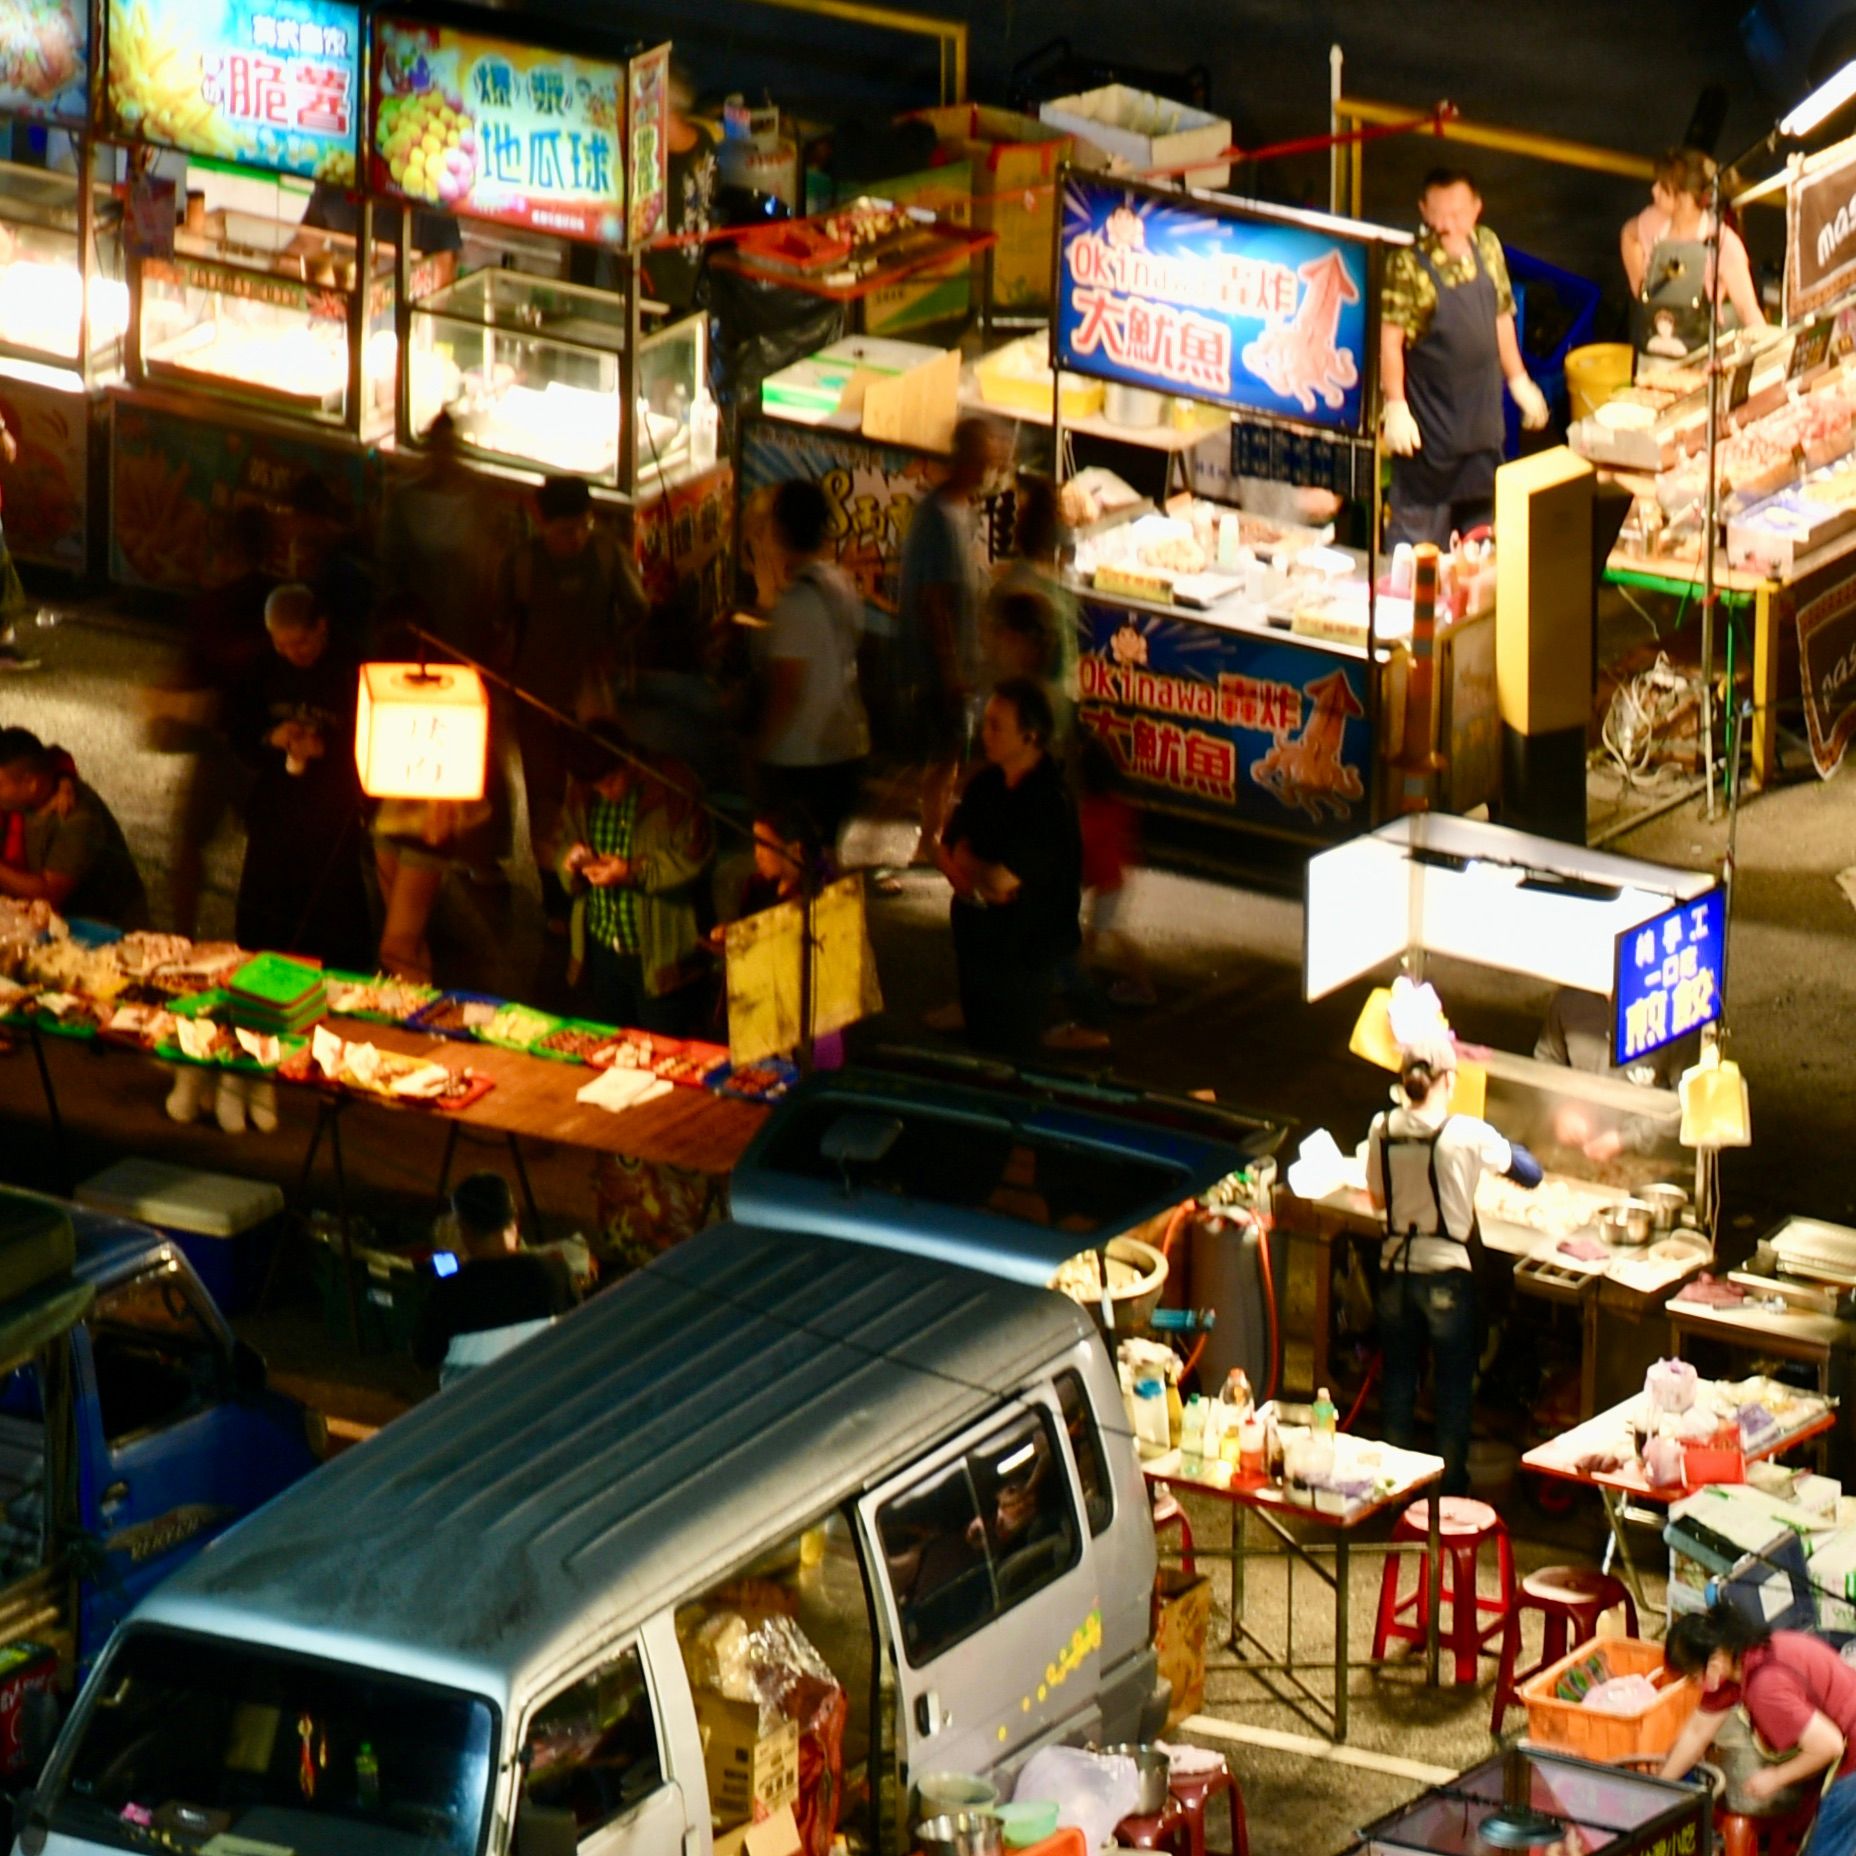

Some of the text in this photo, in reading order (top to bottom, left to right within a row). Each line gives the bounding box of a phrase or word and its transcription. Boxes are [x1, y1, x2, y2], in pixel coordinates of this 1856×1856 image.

[481, 120, 611, 193] 地瓜球
[1075, 290, 1226, 387] 大魷魚
[1078, 658, 1215, 718] Okinawa
[1079, 708, 1235, 801] 大魷魚
